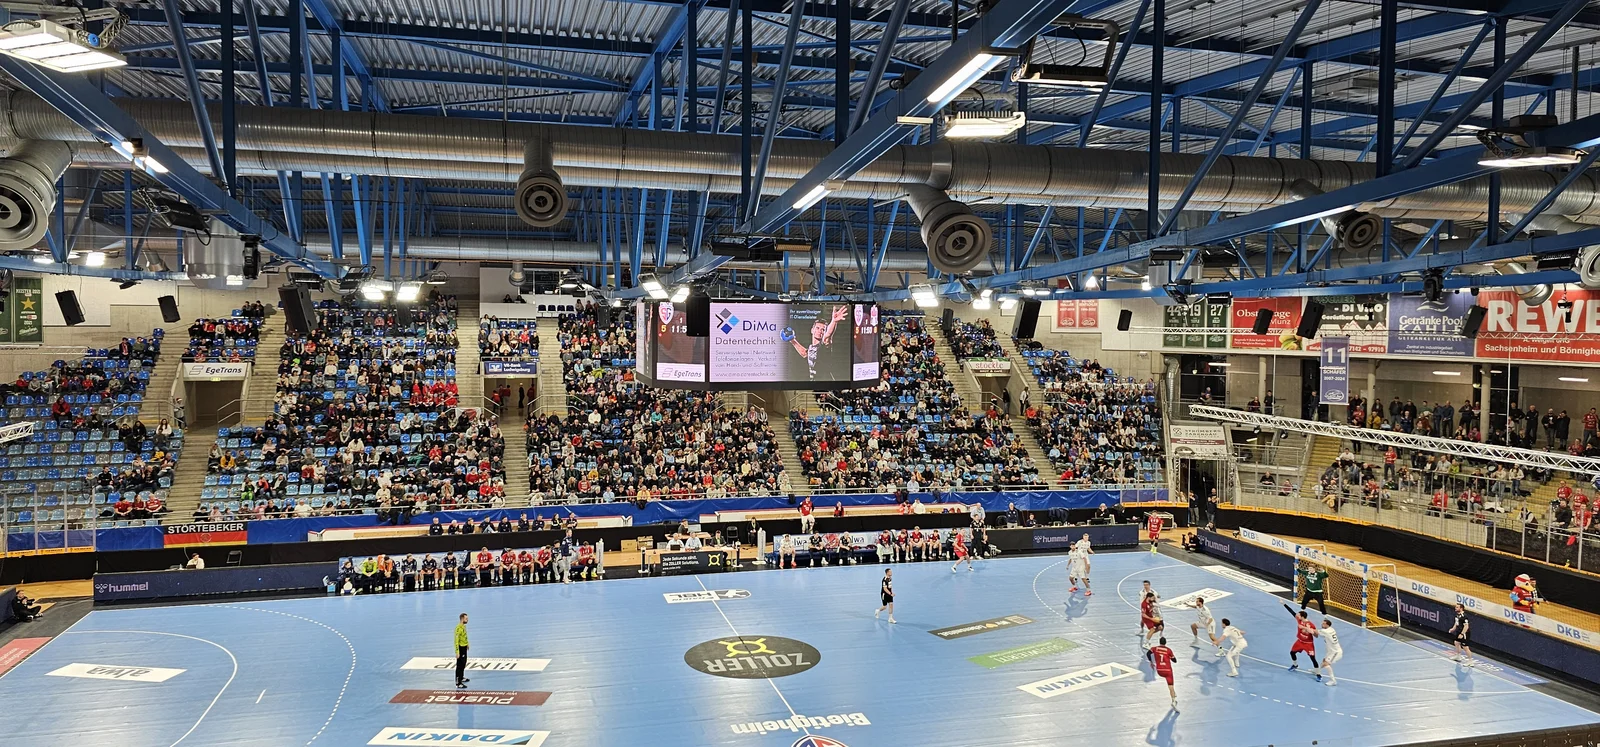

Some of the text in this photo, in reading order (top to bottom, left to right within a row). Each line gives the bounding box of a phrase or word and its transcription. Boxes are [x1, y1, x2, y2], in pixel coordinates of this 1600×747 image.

[1210, 304, 1223, 316] 27
[1342, 304, 1354, 312] DI
[1400, 316, 1463, 325] Getränke Pool
[1488, 300, 1600, 333] REWE
[742, 320, 777, 331] DiMa
[1485, 344, 1538, 353] Sachsenheim
[1324, 347, 1345, 363] 11
[674, 370, 702, 378] EgeTrans
[168, 523, 244, 534] STÖRTEBEKER
[1204, 536, 1230, 554] hummel
[109, 582, 149, 592] hummel
[1412, 583, 1429, 594] DKB
[1456, 594, 1475, 608] DKB
[1399, 599, 1440, 622] hummel
[1504, 609, 1525, 622] DKB
[1557, 624, 1580, 639] DKB
[703, 653, 811, 672] ZOLLER
[1159, 654, 1164, 662] 7
[86, 666, 152, 678] alwa
[1036, 671, 1108, 693] DAIKIN
[425, 695, 514, 705] Plusnet
[731, 713, 872, 735] Bietigheim
[387, 732, 506, 742] DAIKIN
